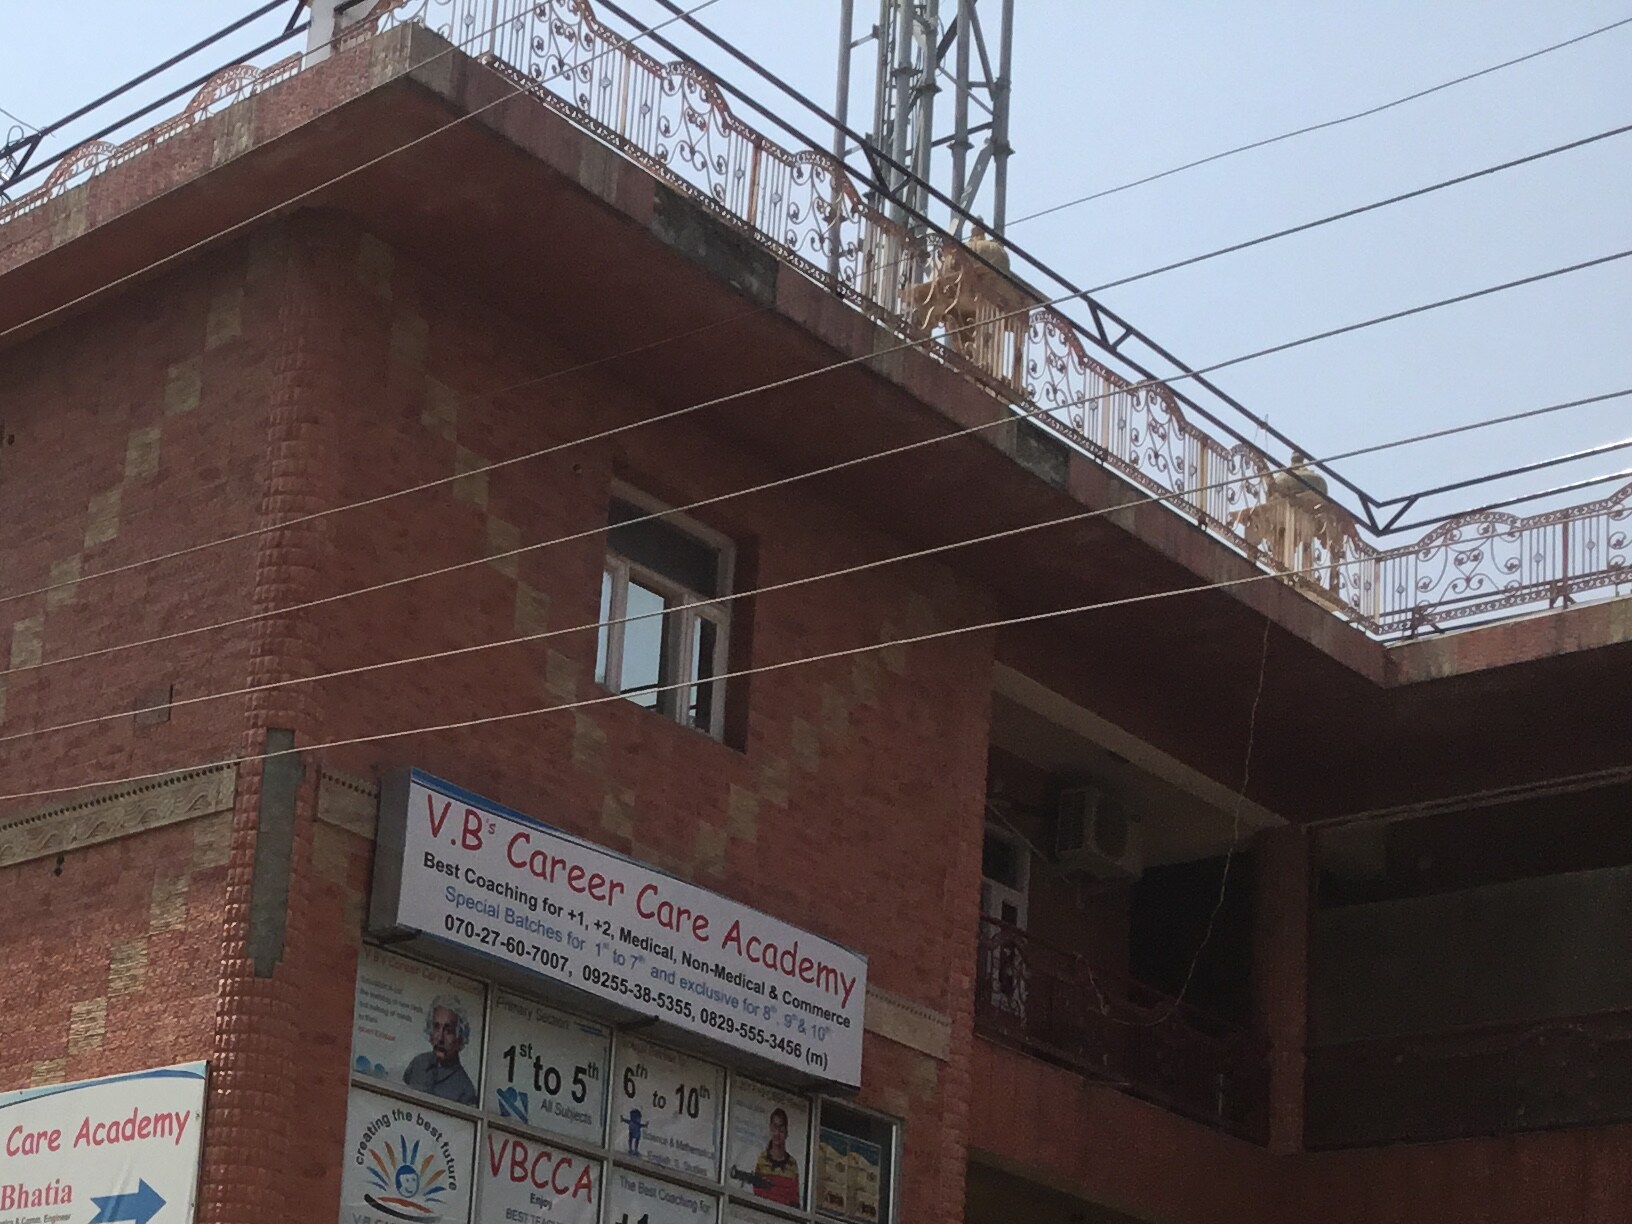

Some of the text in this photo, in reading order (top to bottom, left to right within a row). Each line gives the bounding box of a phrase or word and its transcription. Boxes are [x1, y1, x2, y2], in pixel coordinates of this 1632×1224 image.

[423, 851, 851, 1029] Best Coaching for +1, +2, Medical, Non-Medical & Commerce
[506, 832, 624, 906] Career
[635, 884, 710, 942] Care
[722, 920, 856, 1009] Academy
[445, 886, 500, 919] Special
[505, 908, 562, 942] Batches
[567, 932, 586, 950] for
[613, 950, 625, 965] to
[651, 966, 675, 984] and
[679, 977, 739, 1008] exclusive
[743, 1000, 760, 1016] for
[503, 1042, 599, 1104] 1st to 5th
[805, 1044, 828, 1072] (m)
[540, 1098, 592, 1125] All Subjects
[624, 1064, 648, 1099] 6th
[652, 1091, 666, 1109] to
[676, 1084, 710, 1119] 10th
[5, 1125, 61, 1158] Care
[73, 1107, 191, 1149] Academy
[355, 1108, 457, 1191] creating the best future
[0, 1177, 73, 1212] Bhatia
[488, 1134, 593, 1203] VBCCA
[620, 1176, 636, 1191] The
[638, 1181, 657, 1198] Best
[659, 1188, 698, 1213] Coaching
[506, 1208, 529, 1223] BEST
[529, 1192, 553, 1210] Enjoy
